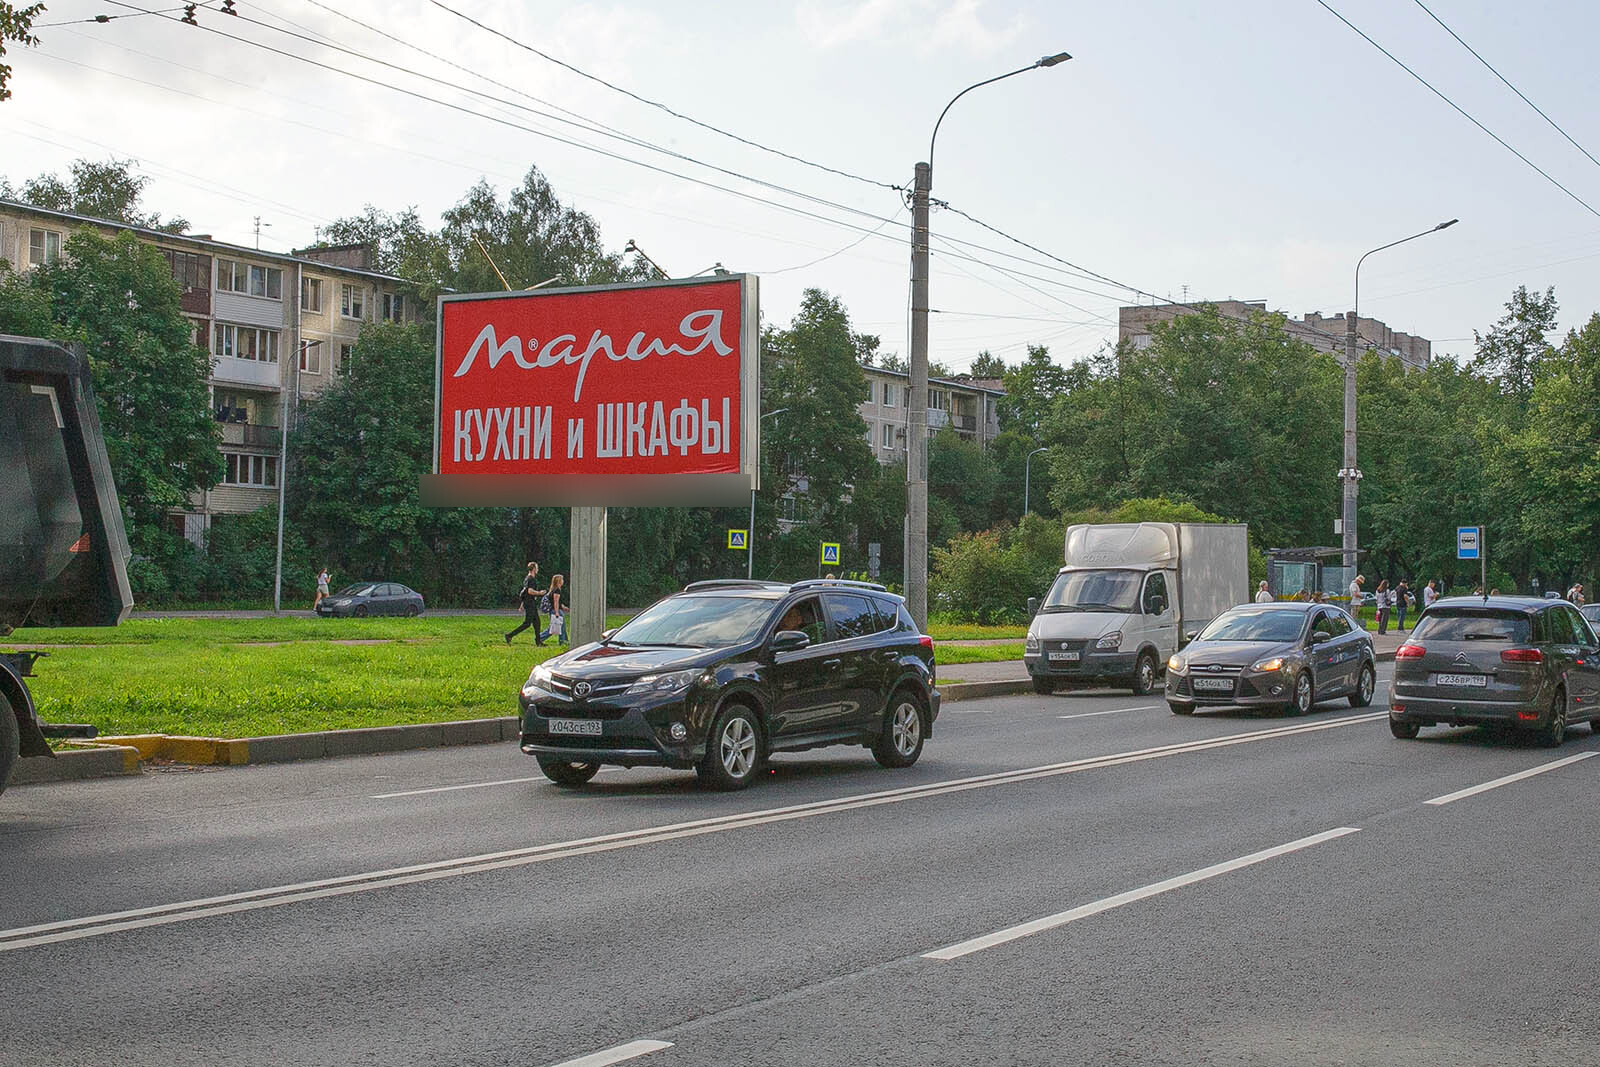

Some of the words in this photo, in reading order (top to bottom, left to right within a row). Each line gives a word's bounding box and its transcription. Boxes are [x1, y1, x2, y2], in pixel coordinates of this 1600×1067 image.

[453, 309, 733, 403] Мария
[453, 405, 553, 462] КУХНИ
[567, 418, 584, 459] и
[596, 397, 730, 458] ШКАФЫ
